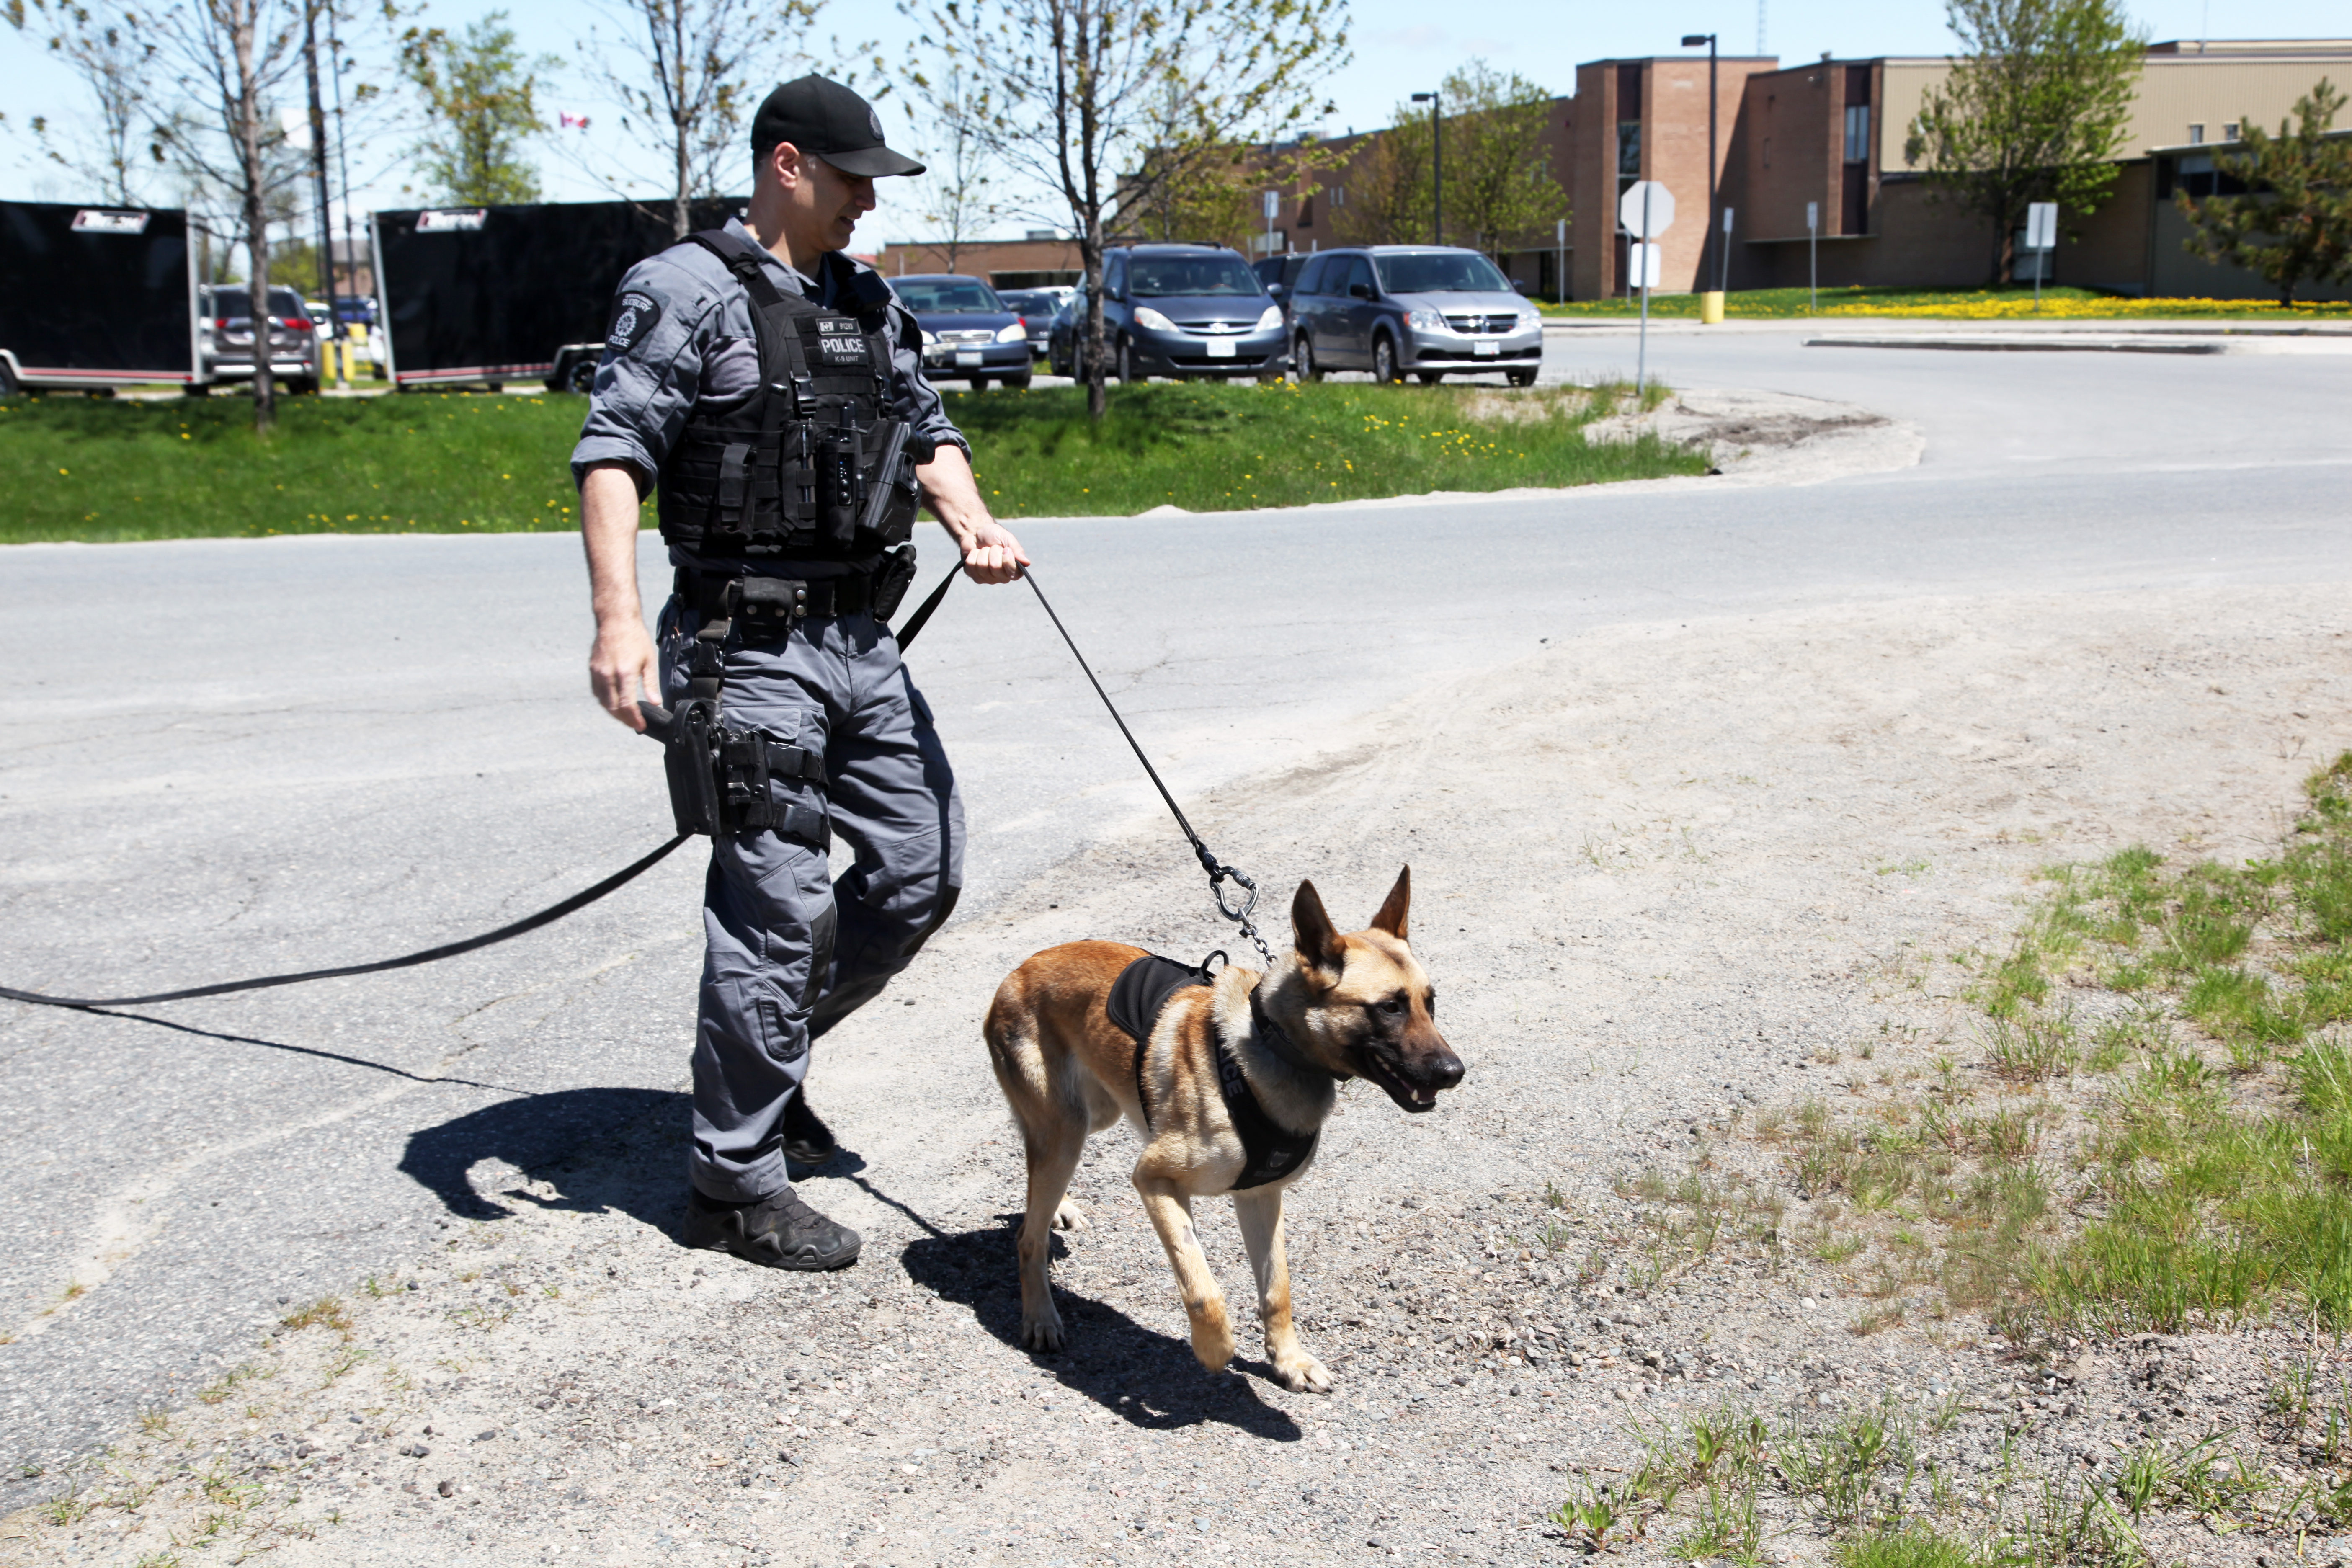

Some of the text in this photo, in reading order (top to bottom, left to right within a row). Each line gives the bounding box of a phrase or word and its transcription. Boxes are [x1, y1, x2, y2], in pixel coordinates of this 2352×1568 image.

[622, 298, 652, 312] SUDBURY
[608, 335, 631, 347] POLICE
[821, 338, 865, 353] POLICE
[1218, 1044, 1244, 1098] LICE
